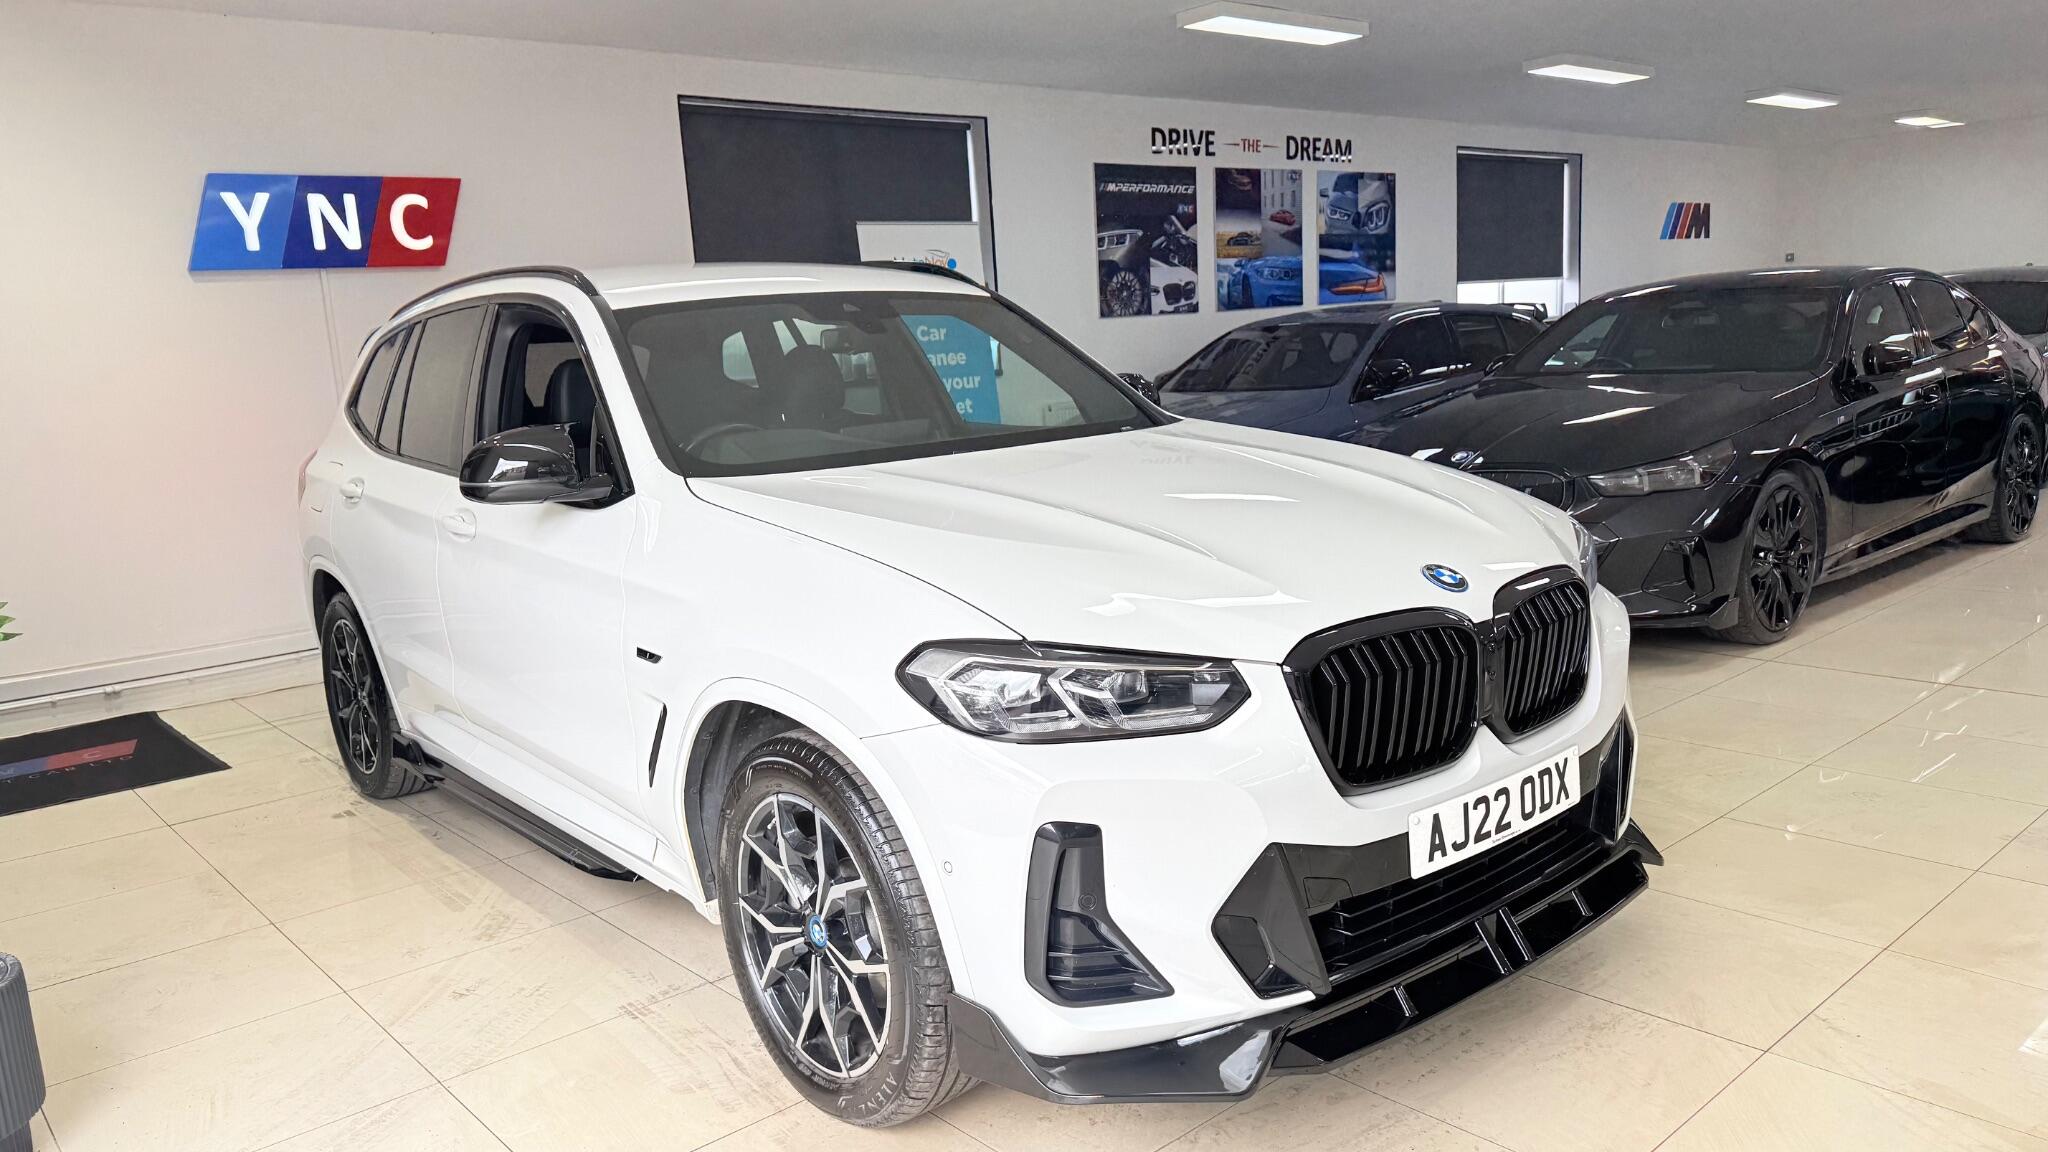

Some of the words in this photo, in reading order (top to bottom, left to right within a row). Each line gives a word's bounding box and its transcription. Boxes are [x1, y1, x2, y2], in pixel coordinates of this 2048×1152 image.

[1151, 127, 1216, 157] DRIVE
[1240, 138, 1262, 153] THE
[1286, 135, 1352, 163] DREAM
[916, 325, 947, 342] Car
[942, 375, 981, 393] your
[1427, 786, 1512, 863] AJ22
[1519, 757, 1570, 822] ODX
